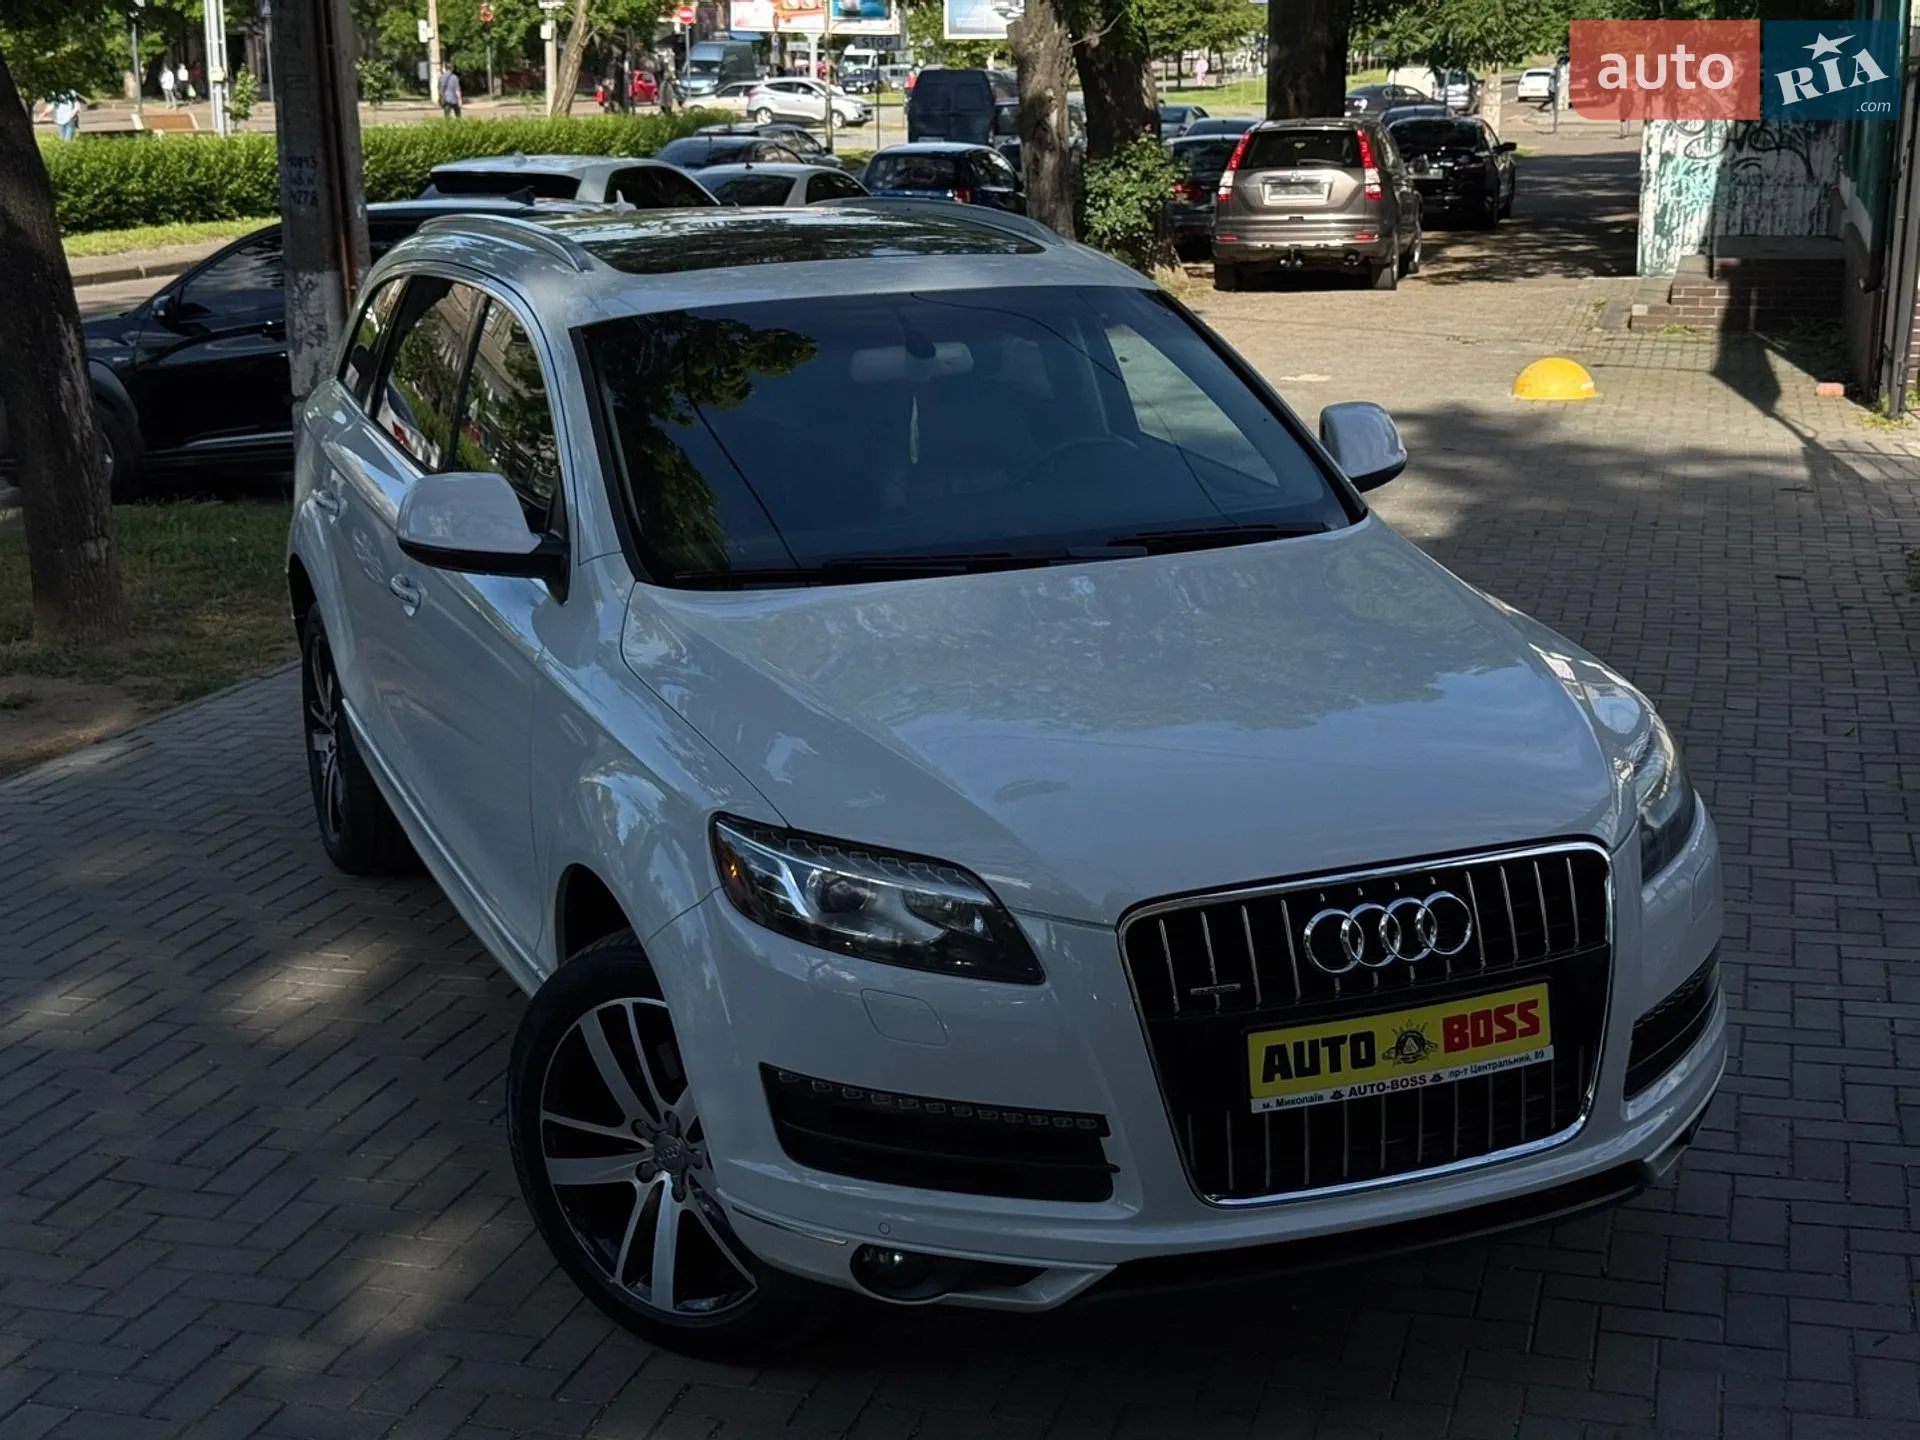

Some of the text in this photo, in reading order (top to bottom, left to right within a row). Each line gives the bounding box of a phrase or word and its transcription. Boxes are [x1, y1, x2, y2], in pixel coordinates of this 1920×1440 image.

[862, 37, 893, 48] STOP
[1262, 1030, 1376, 1084] AUTO
[1442, 999, 1541, 1054] BOSS
[1447, 1067, 1469, 1080] пр-т
[1348, 1074, 1428, 1098] AUTO-BOSS
[1276, 1093, 1324, 1108] Миколаїв
